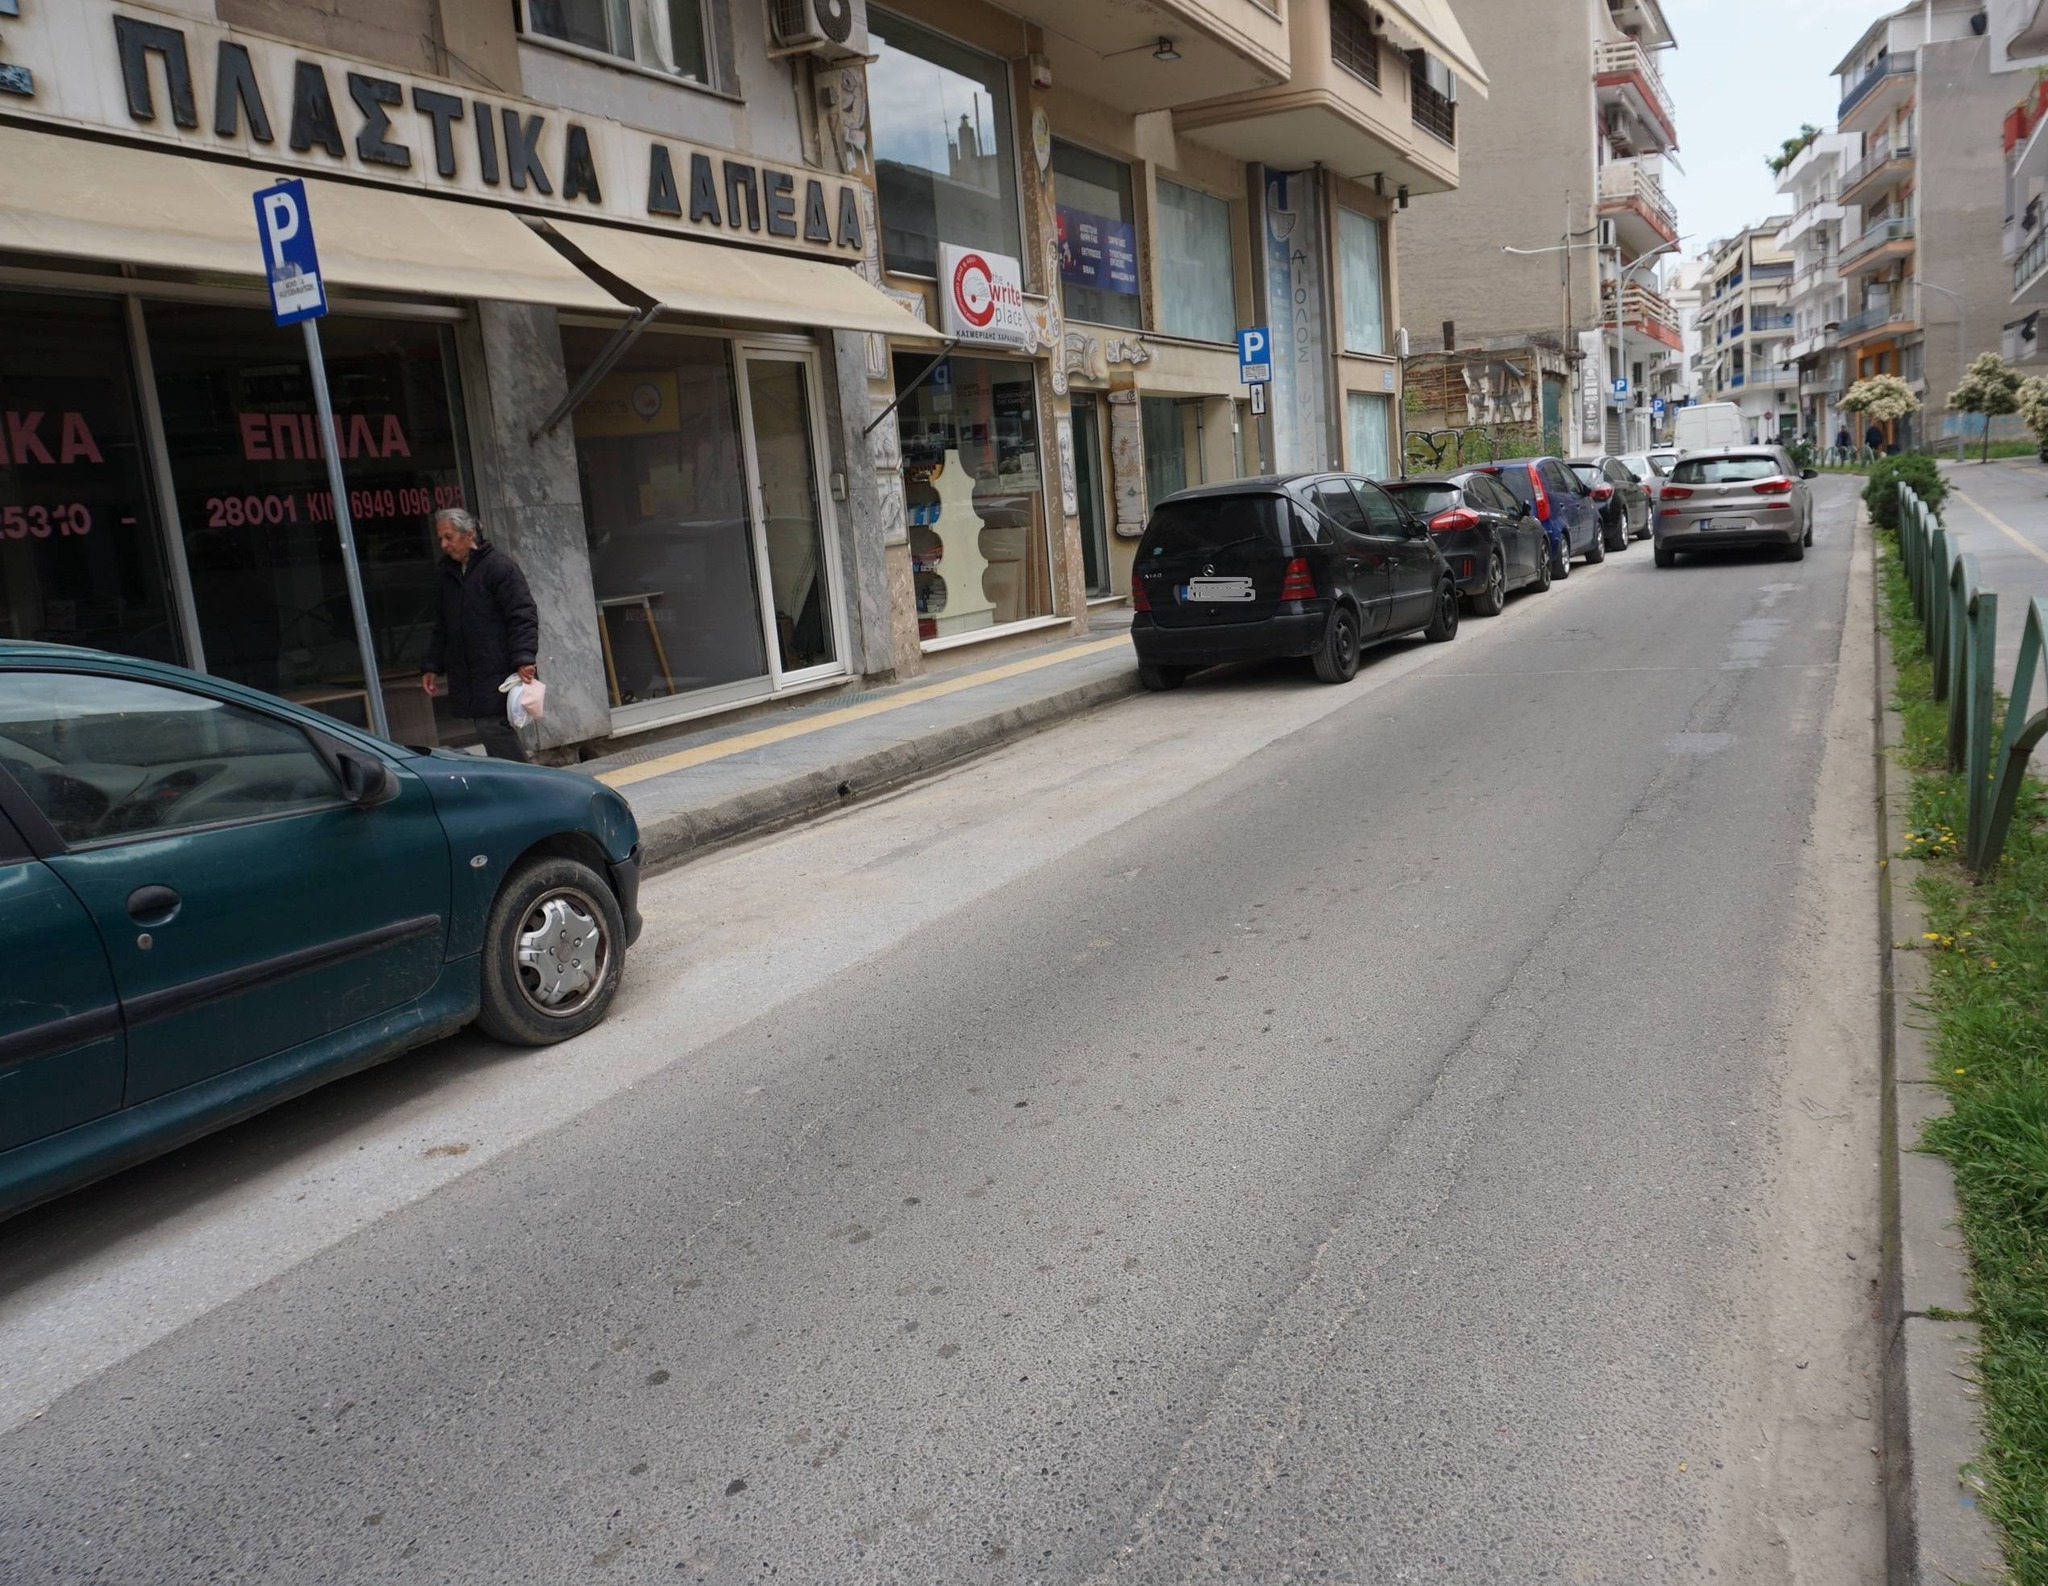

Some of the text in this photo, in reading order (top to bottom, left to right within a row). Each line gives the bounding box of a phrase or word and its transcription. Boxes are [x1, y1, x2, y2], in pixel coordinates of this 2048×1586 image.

[113, 14, 602, 204] ΠΛΑΣΤΙΚΑ
[647, 142, 862, 250] ΔΑΠΕΔΑ
[263, 192, 299, 269] P
[992, 272, 1003, 285] the
[989, 282, 1021, 307] write
[1290, 249, 1309, 363] ΑΙΟΛΟΣ
[995, 304, 1022, 327] place
[956, 330, 996, 340] ΚΑΣΜΕΡΙΔΗΣ
[1243, 332, 1264, 362] P
[1616, 380, 1625, 391] P
[1654, 400, 1662, 411] P
[0, 503, 92, 539] 5310
[206, 495, 297, 527] 28001
[351, 489, 396, 519] 6949
[400, 487, 431, 516] 096
